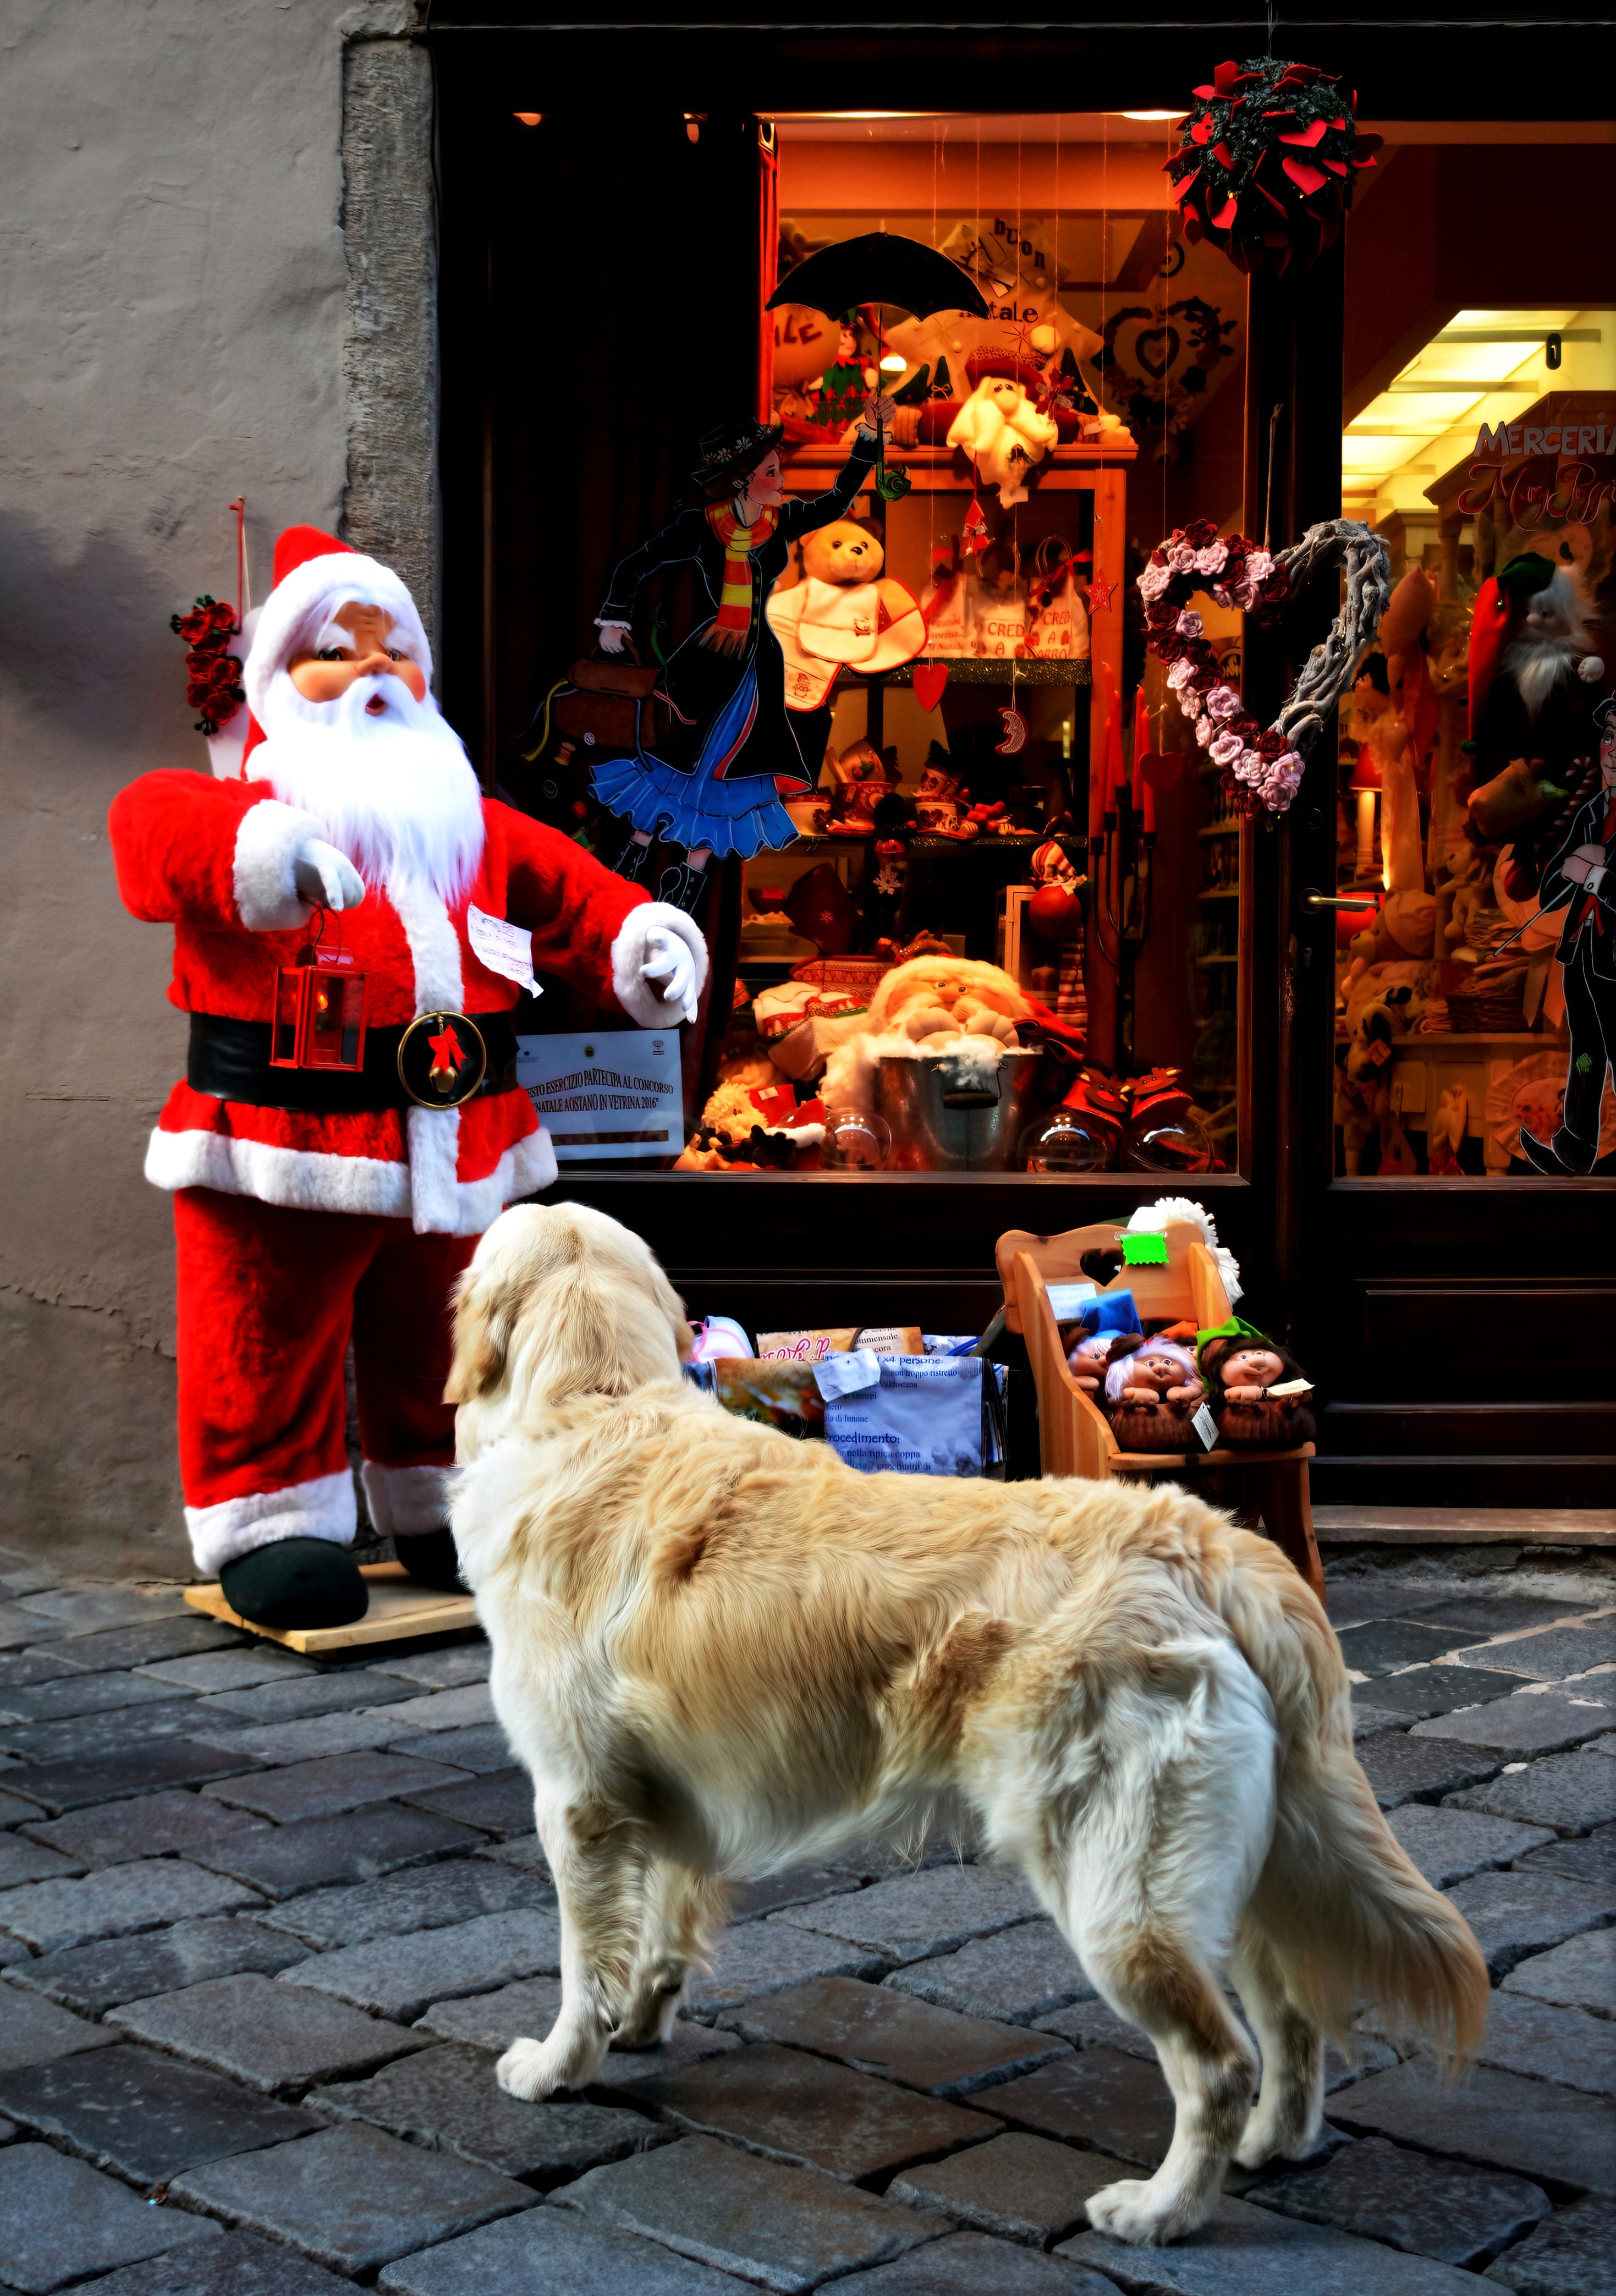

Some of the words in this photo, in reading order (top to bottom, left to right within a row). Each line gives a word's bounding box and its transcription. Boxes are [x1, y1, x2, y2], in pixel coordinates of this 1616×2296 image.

[994, 218, 1045, 269] buon
[959, 302, 1038, 323] tale
[988, 622, 1025, 636] CRED
[546, 1072, 584, 1095] ESERCIZIO
[584, 1068, 622, 1088] PARTECIPA
[622, 1075, 633, 1089] AL
[634, 1077, 674, 1094] CONCORSO
[564, 1094, 598, 1111] AOSTANO
[599, 1094, 607, 1110] IN
[608, 1095, 641, 1109] VETRINA
[899, 1357, 944, 1365] persone:
[905, 1369, 928, 1378] troppo
[844, 1414, 869, 1422] limone
